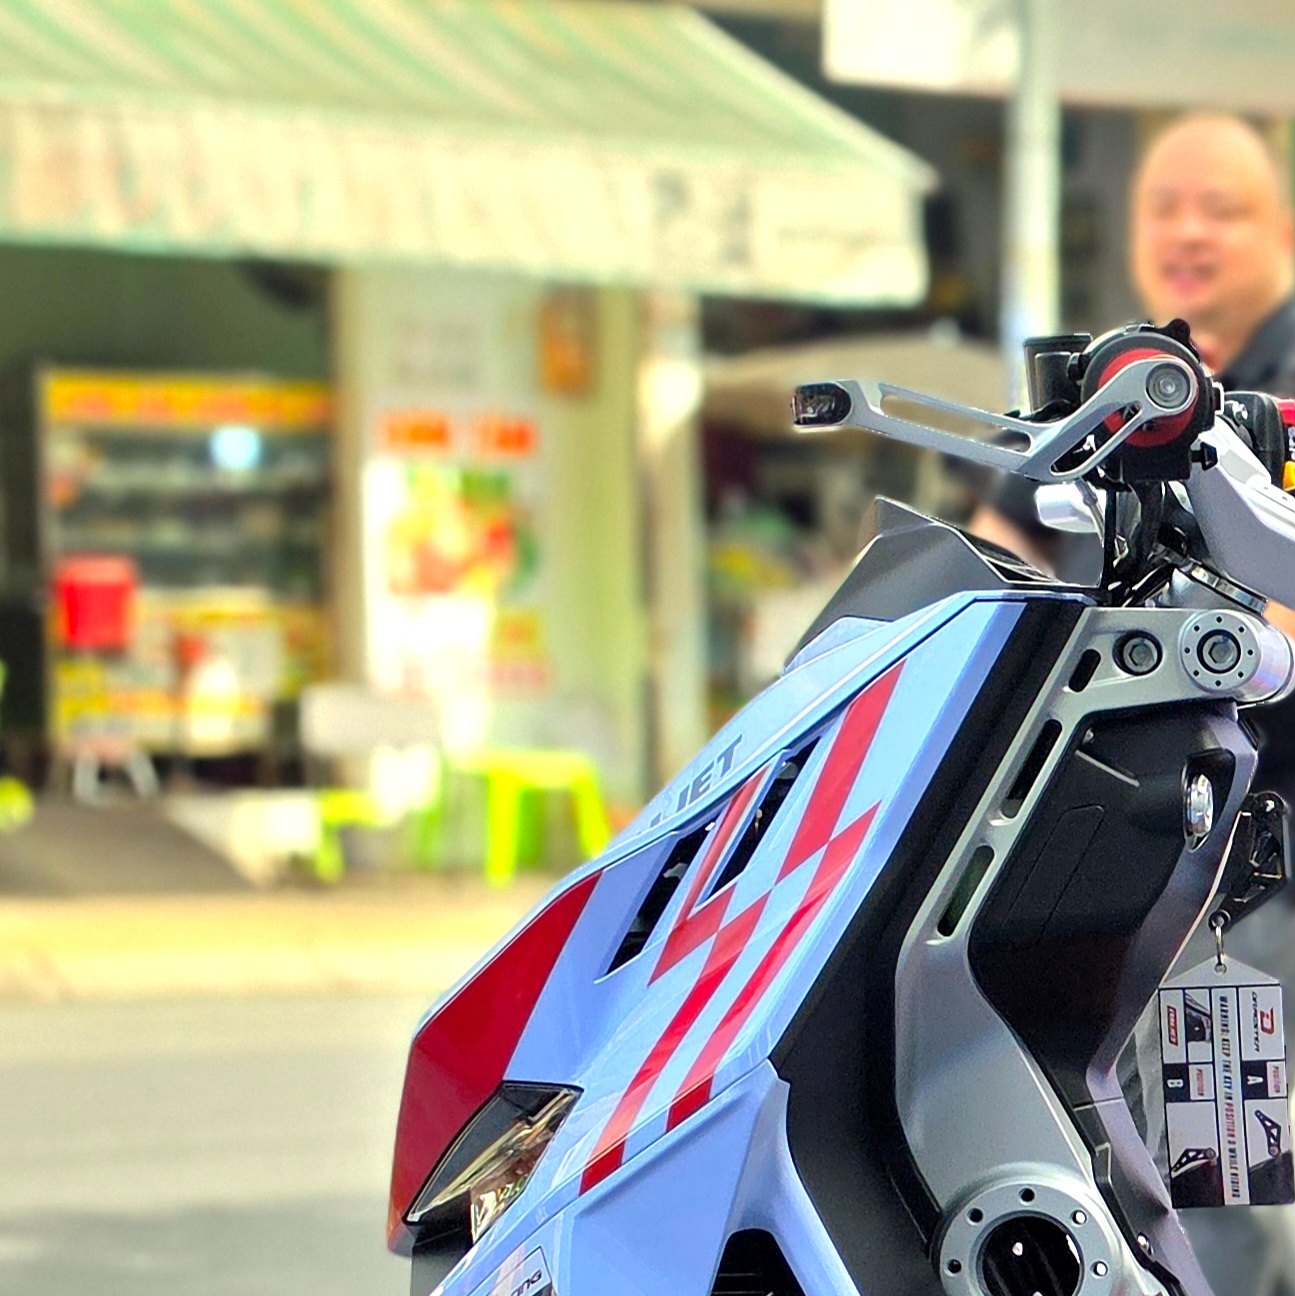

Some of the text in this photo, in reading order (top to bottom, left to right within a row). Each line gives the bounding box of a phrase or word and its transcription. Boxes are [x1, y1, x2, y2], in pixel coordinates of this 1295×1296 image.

[1167, 1078, 1184, 1088] B
[1223, 1076, 1234, 1091] KEY
[1247, 1075, 1264, 1085] A
